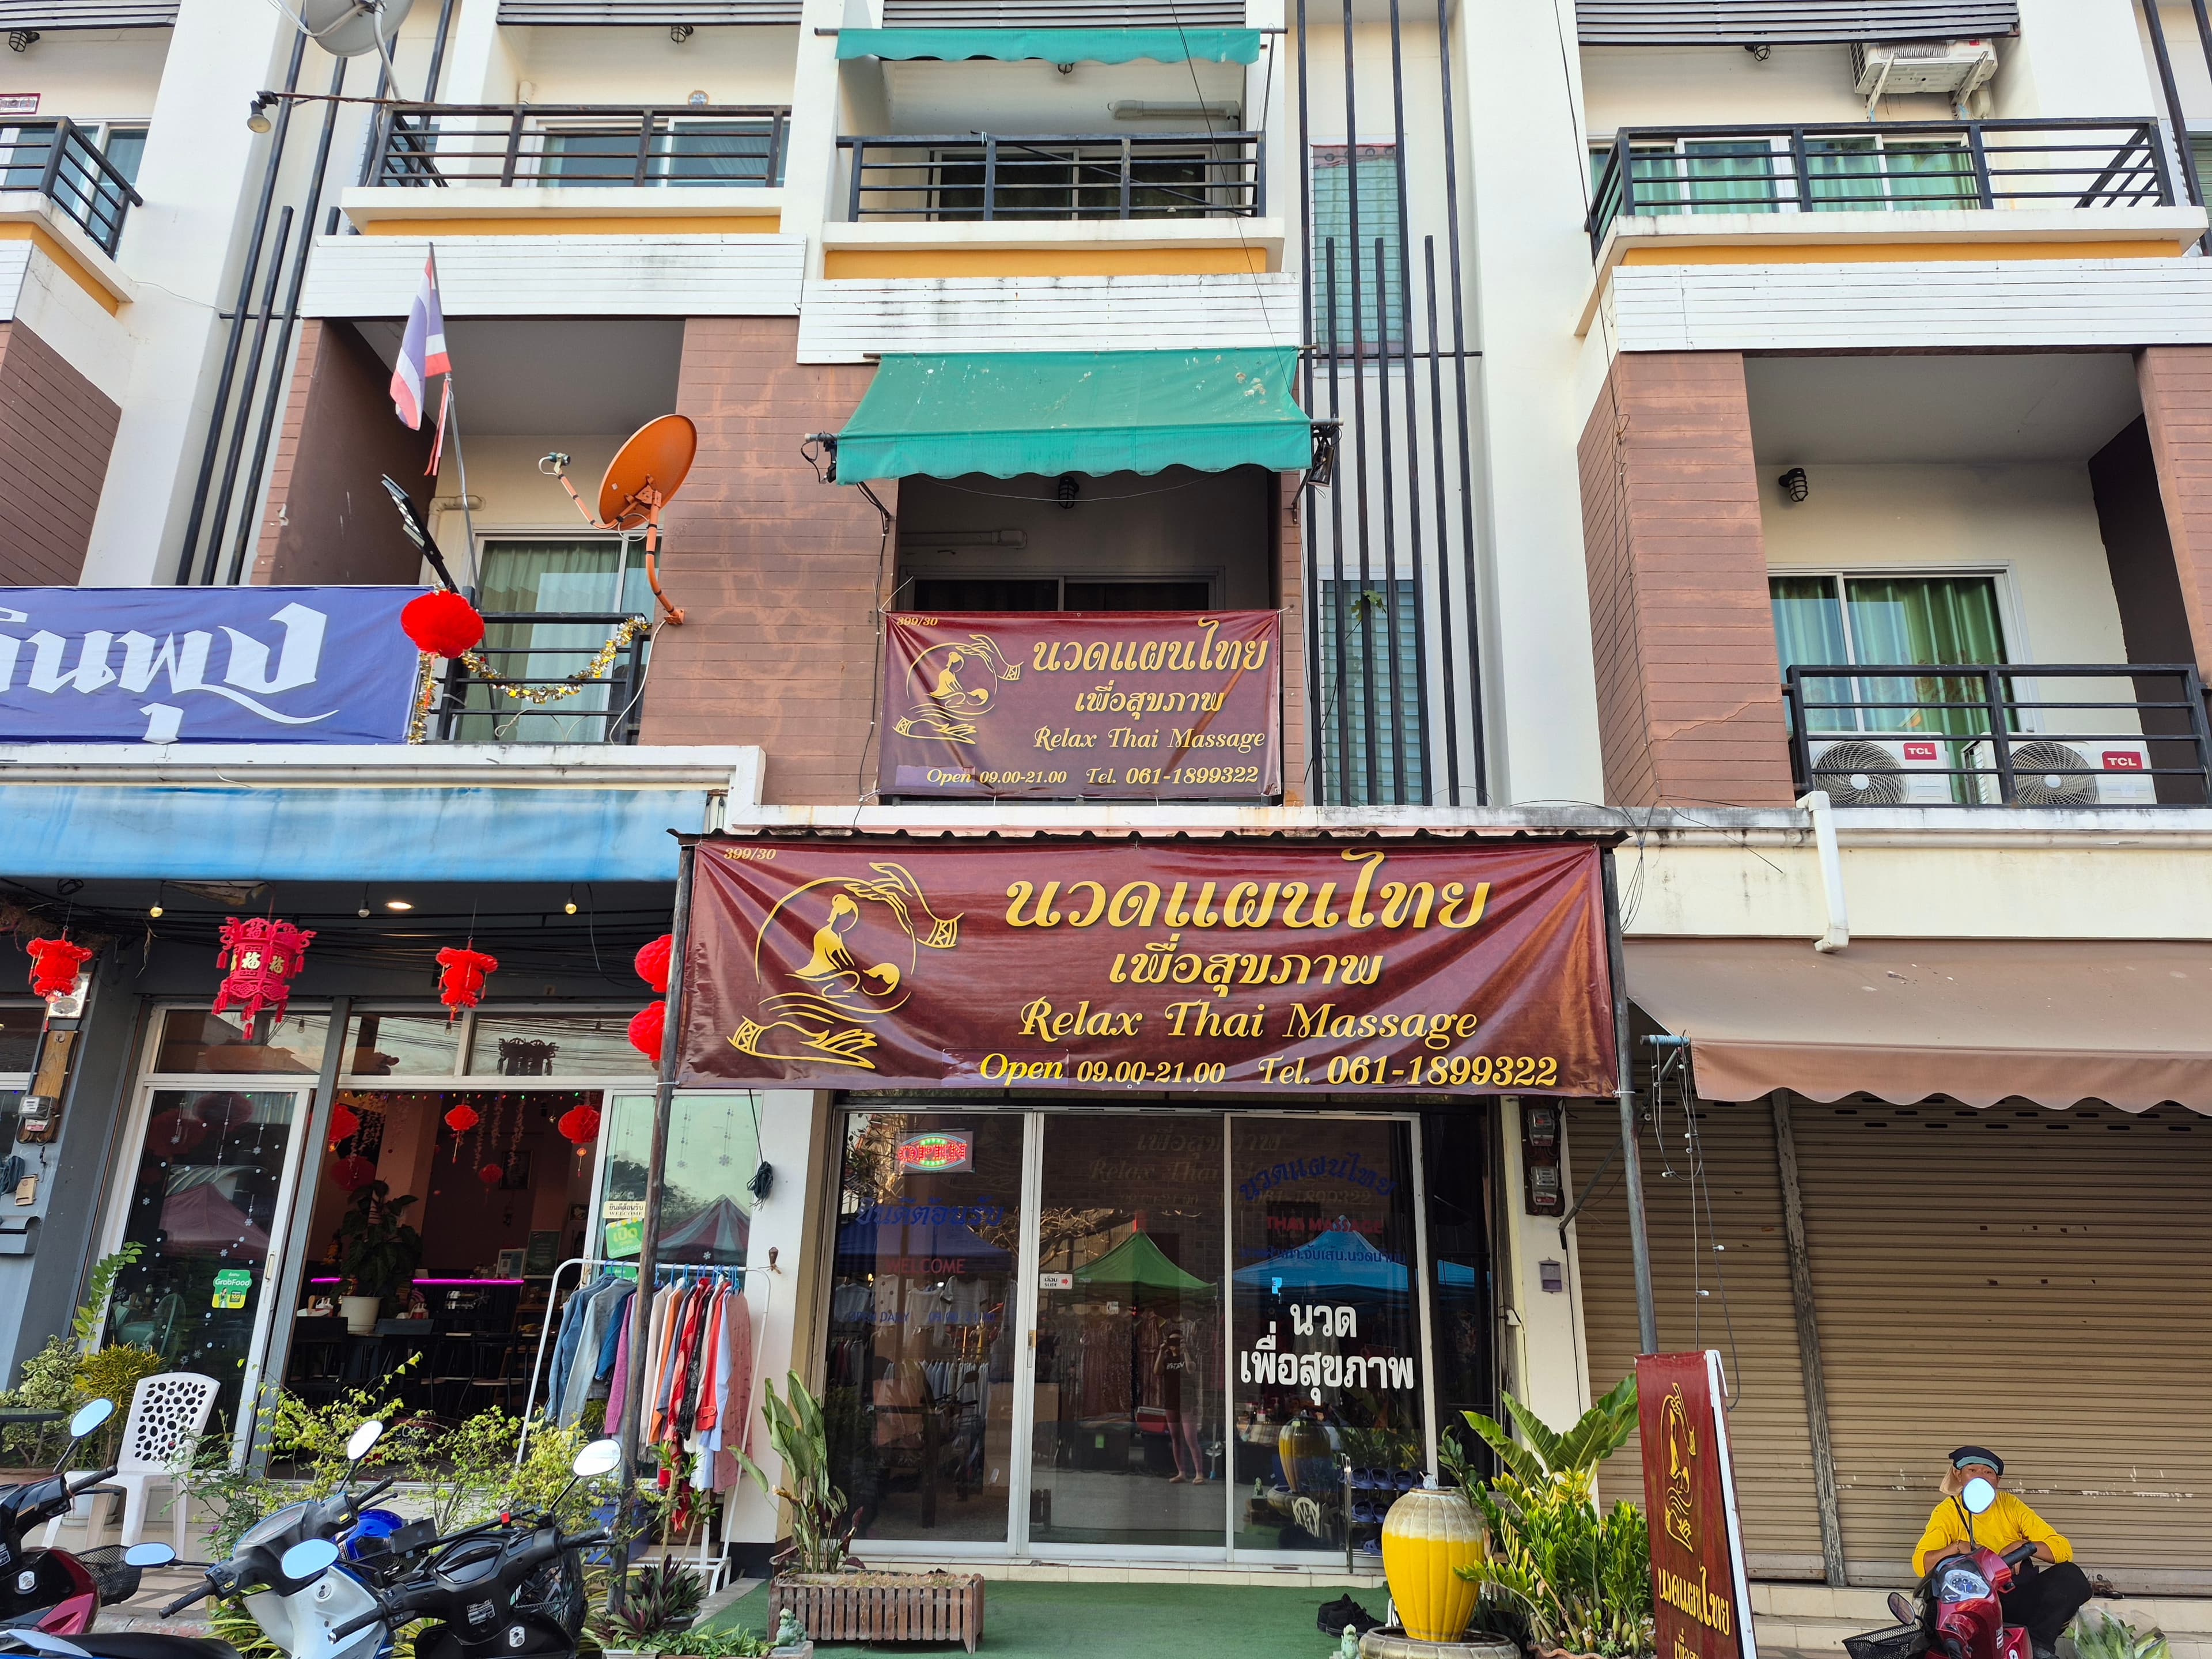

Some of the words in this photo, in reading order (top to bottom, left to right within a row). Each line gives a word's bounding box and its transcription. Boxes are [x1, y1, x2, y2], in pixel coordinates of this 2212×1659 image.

[897, 617, 938, 627] 399/30
[1033, 617, 1268, 672] นวดแผนไทย
[1074, 680, 1225, 720] เพื่อสุขภาพ
[1033, 725, 1097, 752] Relax
[1107, 726, 1159, 748] Thai
[1167, 728, 1265, 753] Massage
[926, 768, 972, 785] Open
[980, 771, 1067, 783] 09.00-21.00
[1086, 767, 1116, 784] Tel.
[1126, 766, 1259, 784] 061-1899322
[2107, 757, 2137, 767] TCL
[724, 847, 777, 861] 399/30
[1005, 847, 1490, 929] นวดแผนไทย
[1109, 933, 1383, 998] เพื่อสุขภาพ
[1018, 996, 1143, 1043] Relax
[1164, 999, 1265, 1037] Thai
[1282, 1003, 1477, 1050] Massage
[980, 1053, 1063, 1086] Open
[1077, 1060, 1226, 1083] 09.00-21.00
[1259, 1055, 1310, 1084] Tel.
[1327, 1055, 1557, 1086] 061-1899322
[897, 1143, 968, 1162] OPEN
[1267, 1216, 1305, 1231] THAI
[1309, 1217, 1384, 1234] MASSAGE
[884, 1258, 966, 1274] WELCOME
[215, 1278, 250, 1286] GrabFood
[1290, 1303, 1357, 1338] นวด
[1241, 1321, 1414, 1406] เพื่อสุขภาพ
[1658, 1560, 1730, 1635] นวดแผนไทย
